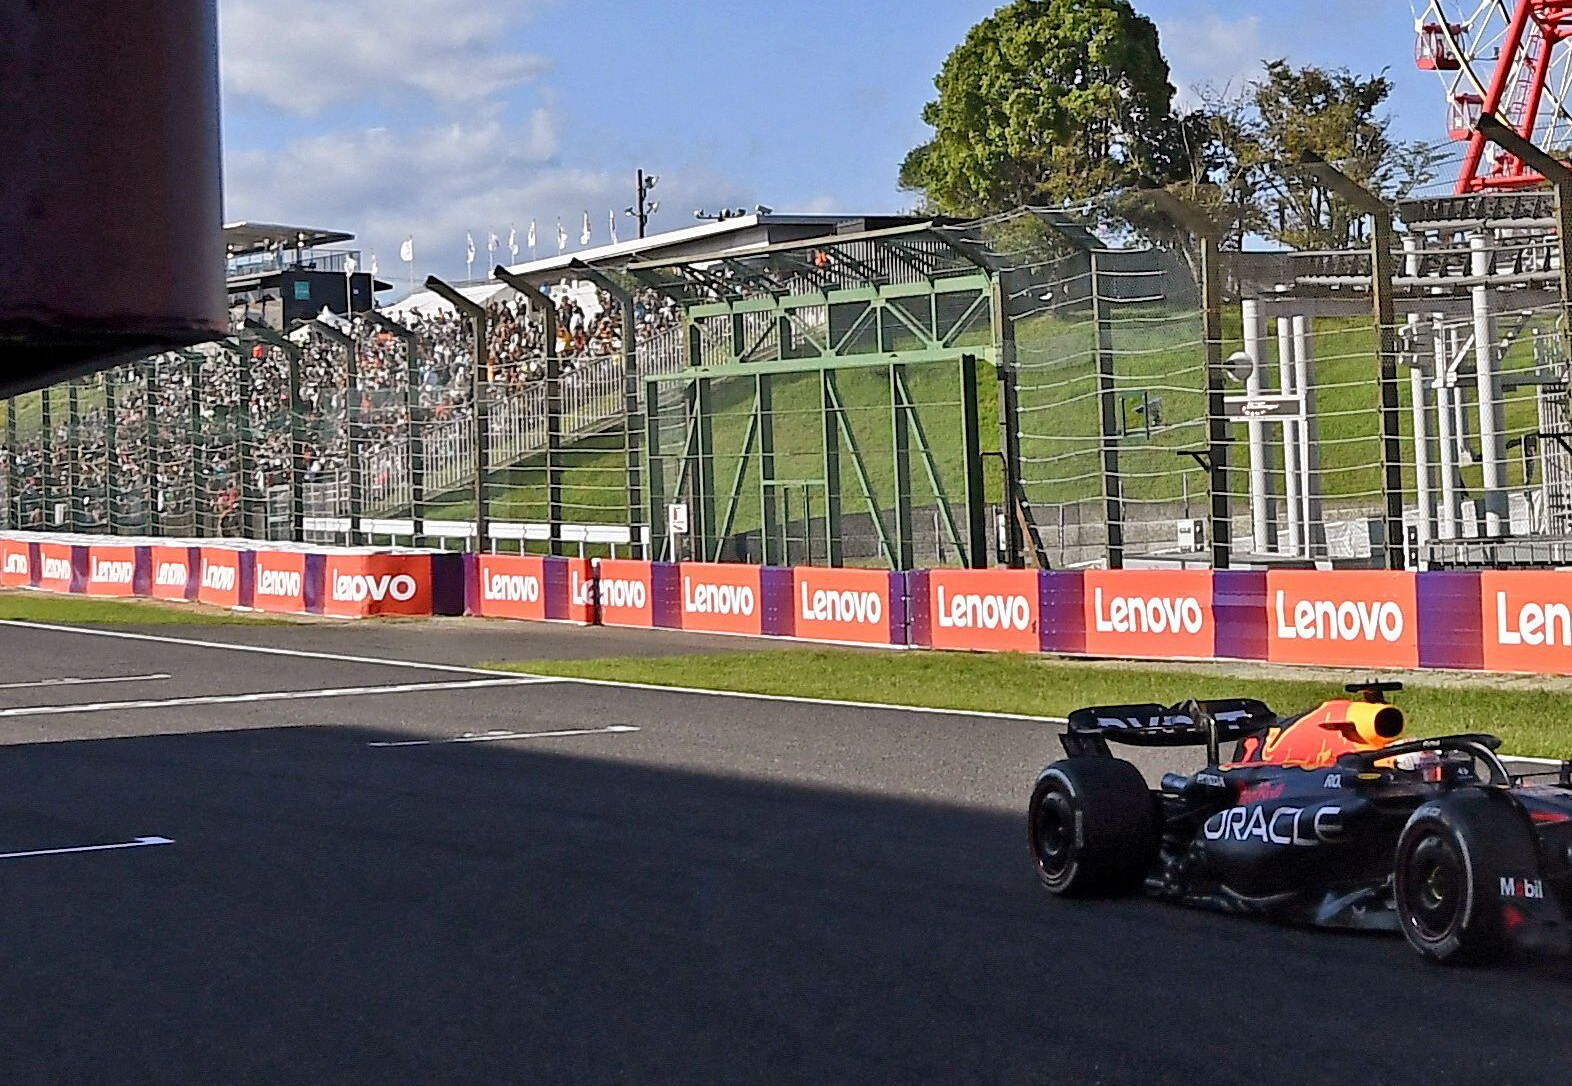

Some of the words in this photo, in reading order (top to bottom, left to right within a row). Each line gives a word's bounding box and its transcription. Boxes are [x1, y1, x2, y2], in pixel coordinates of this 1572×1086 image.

[257, 564, 301, 597] Lenovo
[484, 568, 539, 603] Lenovo
[684, 576, 754, 616] Lenovo
[801, 580, 882, 624] Lenovo
[937, 585, 1030, 631] Lenovo
[1095, 588, 1202, 634] Lenovo
[1276, 589, 1404, 642] Lenovo
[1203, 805, 1345, 847] ORACLE
[1500, 877, 1544, 899] Mobil
